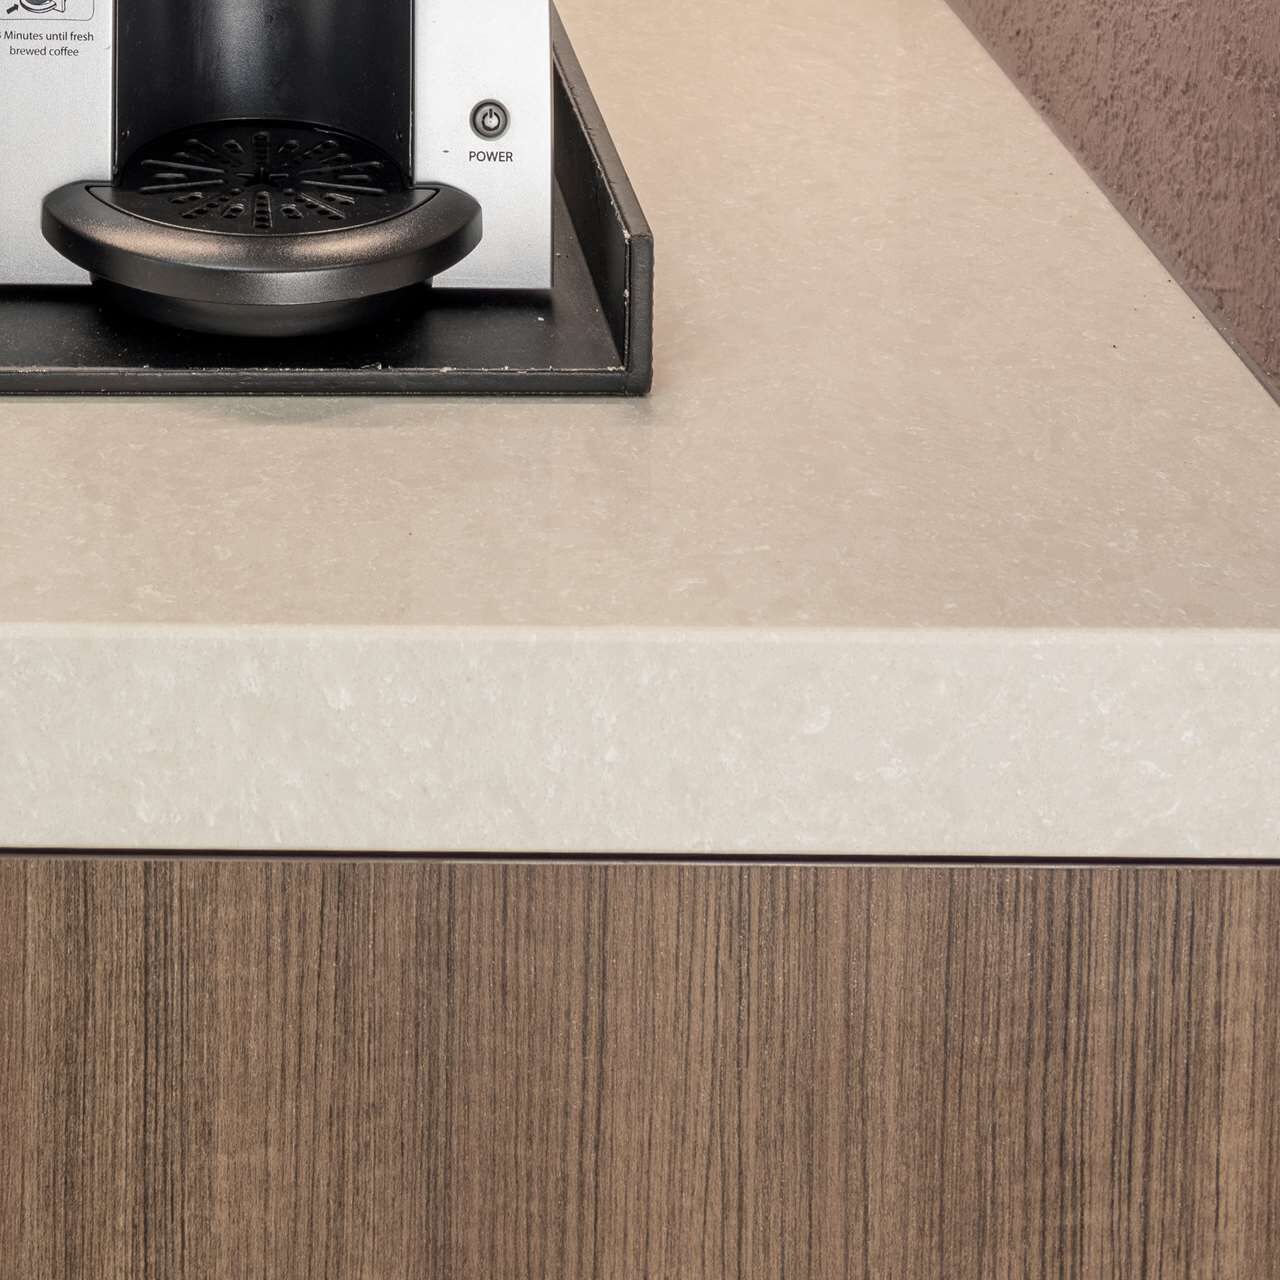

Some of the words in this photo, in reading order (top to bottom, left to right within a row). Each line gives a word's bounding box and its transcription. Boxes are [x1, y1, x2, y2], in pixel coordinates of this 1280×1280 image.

[4, 30, 43, 41] Minutes
[46, 31, 68, 41] until
[70, 31, 94, 42] fresh
[9, 46, 47, 56] brewed
[49, 46, 79, 57] coffee
[468, 150, 514, 162] POWER
